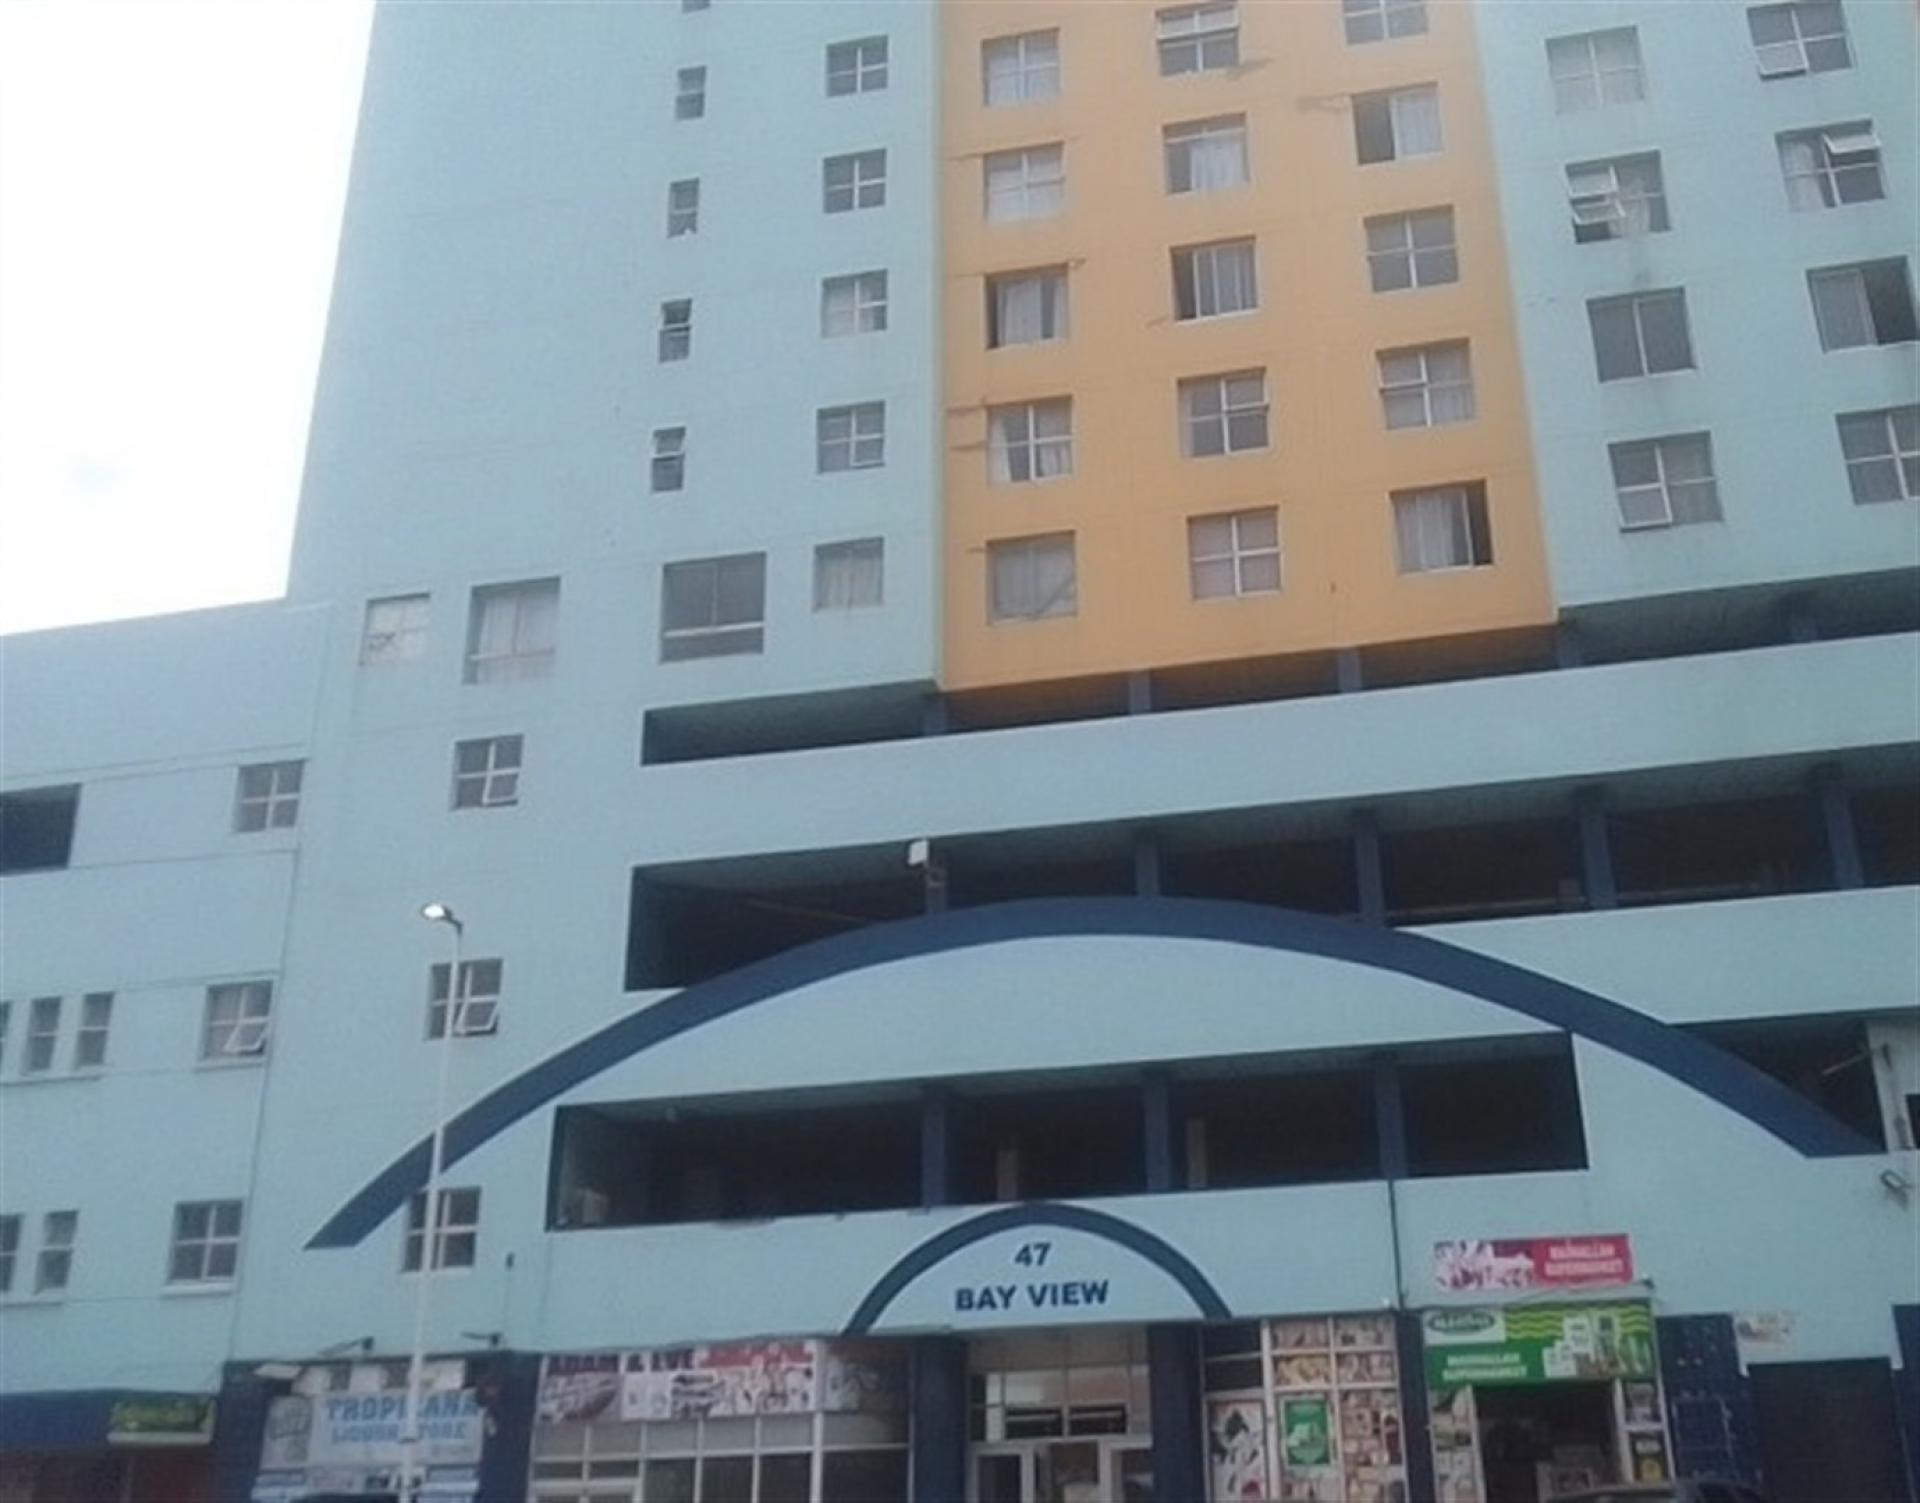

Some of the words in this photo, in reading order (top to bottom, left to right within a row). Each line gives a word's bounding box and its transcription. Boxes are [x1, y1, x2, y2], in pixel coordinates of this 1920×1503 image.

[1014, 1242, 1051, 1267] 47
[955, 1284, 1017, 1311] BAY
[1027, 1279, 1109, 1307] VIEW
[326, 1394, 480, 1419] TROPIANA
[412, 1422, 465, 1439] TORE
